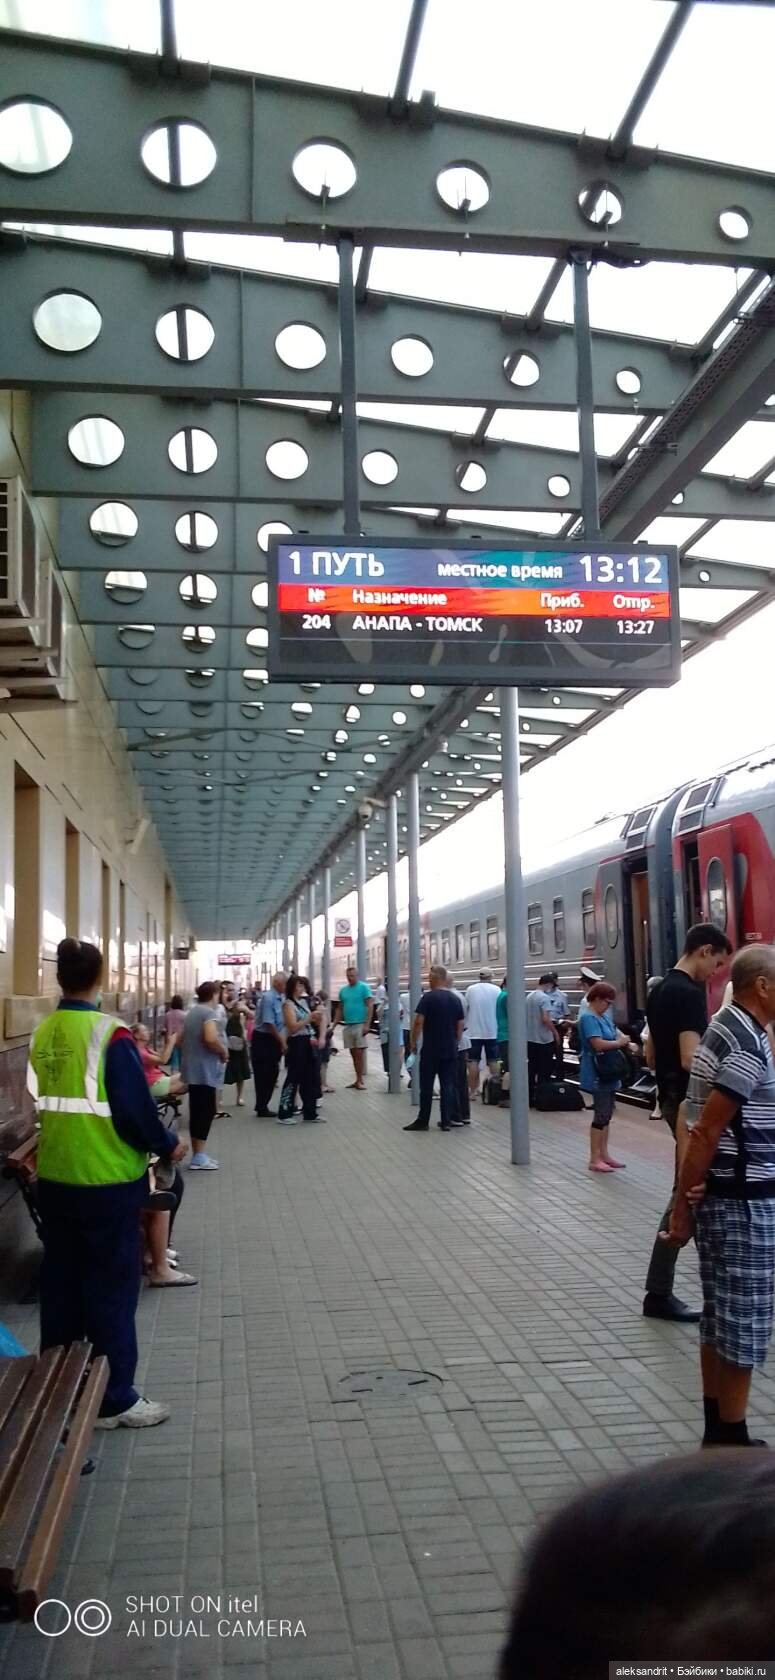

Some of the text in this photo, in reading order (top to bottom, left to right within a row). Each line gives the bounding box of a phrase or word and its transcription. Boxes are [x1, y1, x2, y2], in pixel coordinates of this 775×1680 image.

[288, 551, 385, 577] 1 ПУТЬ
[437, 562, 563, 581] местное время
[579, 555, 662, 584] 13:12
[307, 590, 326, 603] №
[352, 589, 447, 606] Назначение
[540, 593, 585, 610] Приб.
[613, 594, 656, 611] Отпр.
[302, 615, 331, 630] 204
[352, 616, 413, 631] АНАПА
[425, 617, 483, 633] ТОМСК
[544, 619, 583, 634] 13:07
[617, 620, 655, 635] 13:27
